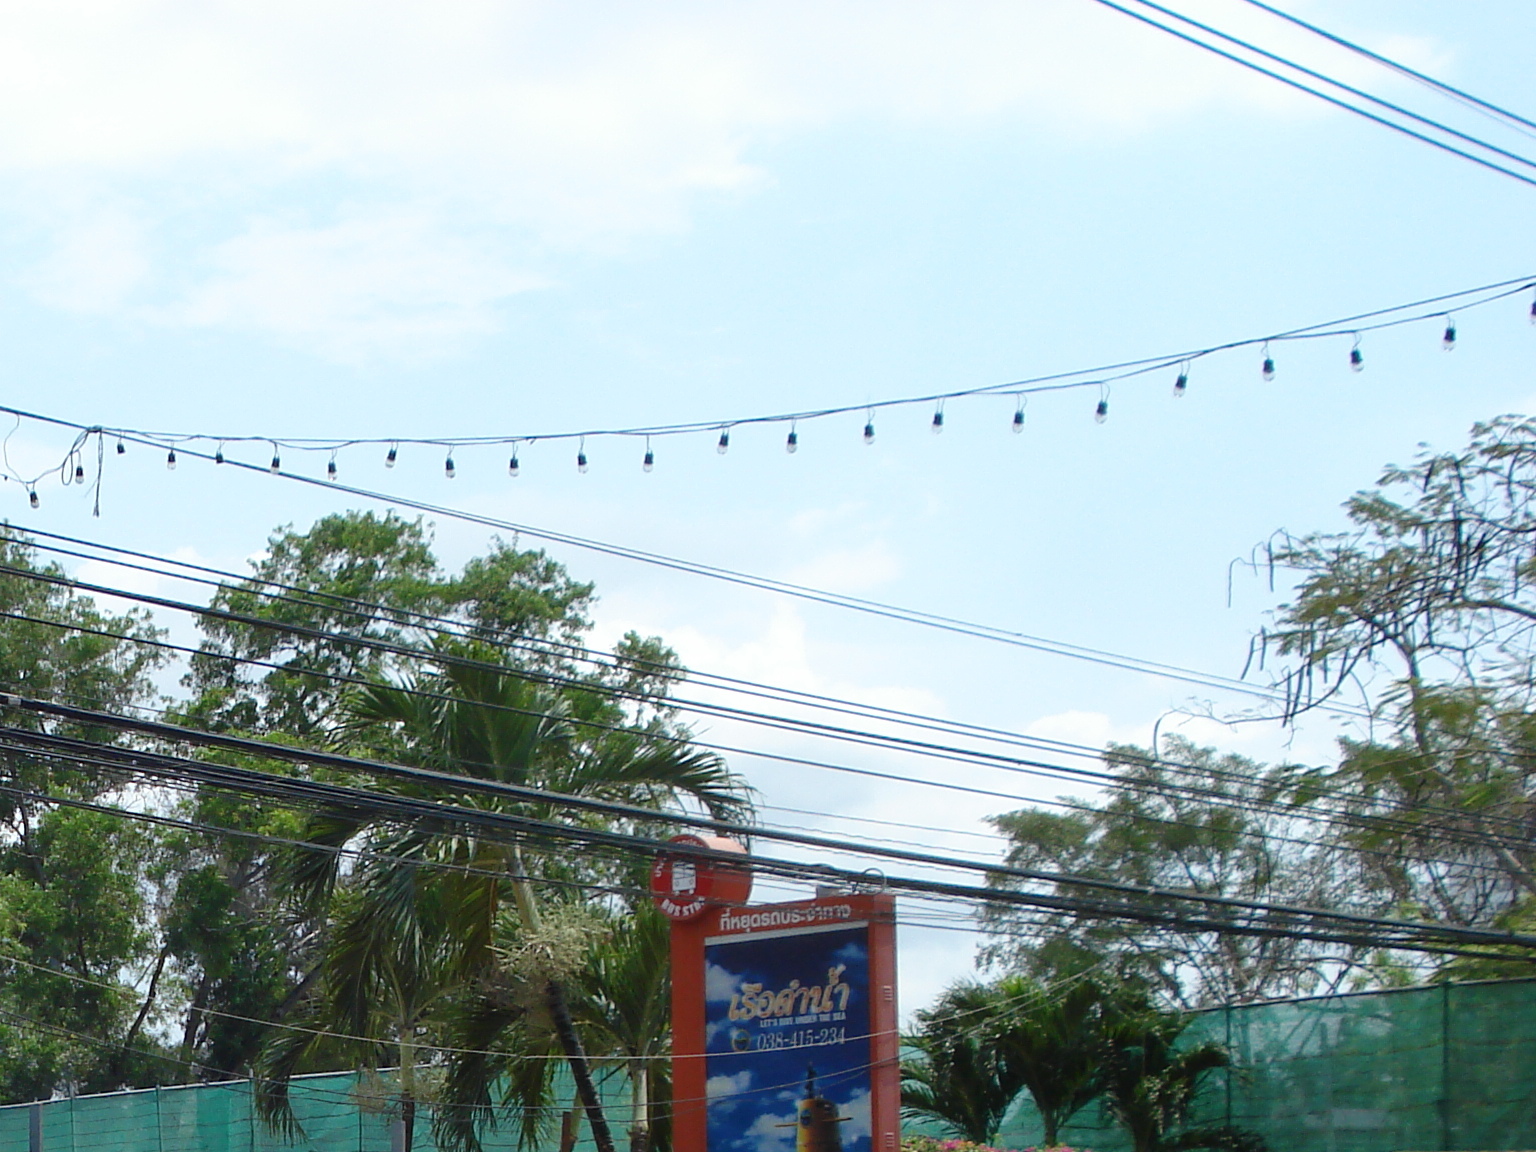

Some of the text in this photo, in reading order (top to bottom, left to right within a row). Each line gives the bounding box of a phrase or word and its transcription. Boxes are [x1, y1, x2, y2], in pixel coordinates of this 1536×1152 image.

[661, 898, 682, 917] BUS
[728, 963, 851, 1021] เรือดำน้ำ
[757, 1027, 846, 1050] 038-415-234
